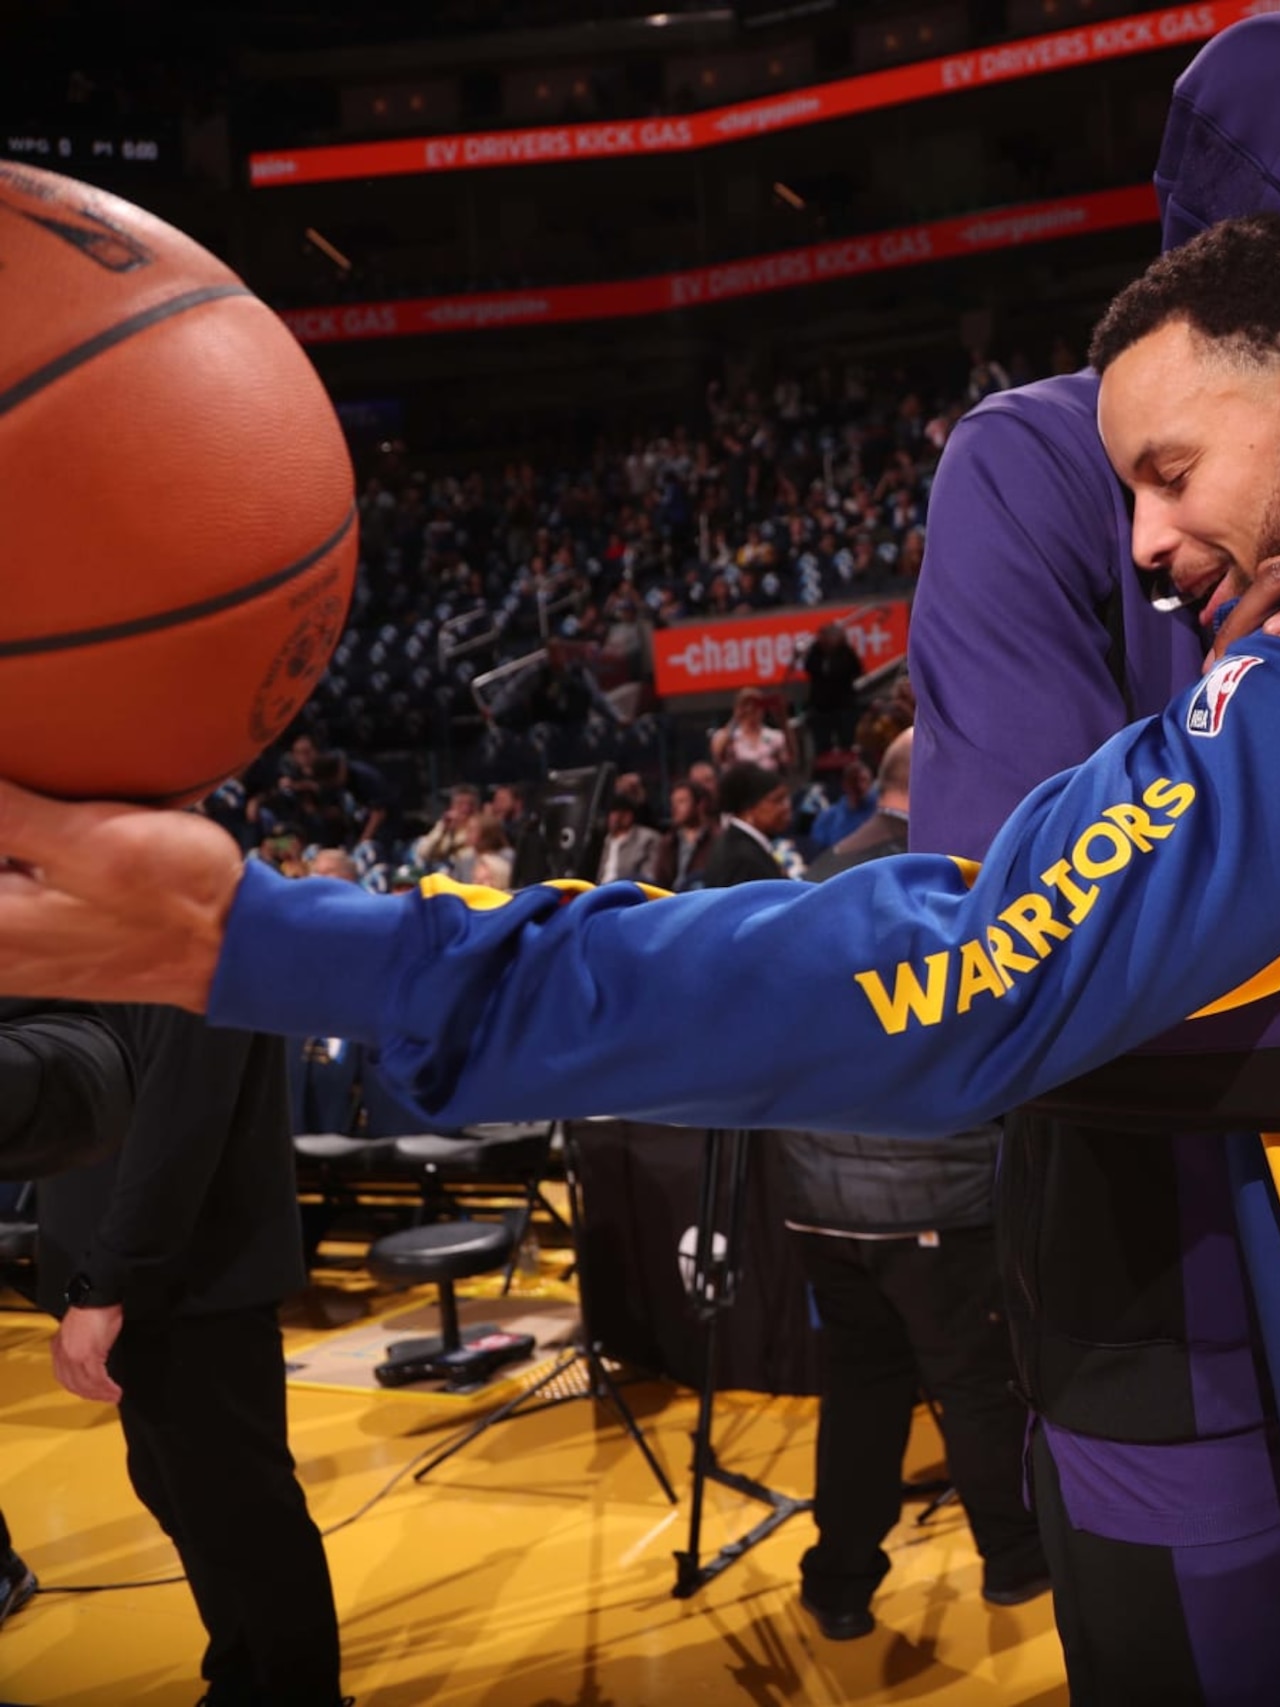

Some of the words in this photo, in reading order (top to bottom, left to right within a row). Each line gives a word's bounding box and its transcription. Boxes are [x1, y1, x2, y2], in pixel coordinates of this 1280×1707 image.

[942, 59, 973, 88] EV
[980, 33, 1088, 80] DRIVERS
[1093, 20, 1153, 54] KICK
[1159, 8, 1216, 43] GAS
[425, 140, 457, 167] EV
[463, 131, 570, 163] DRIVERS
[575, 126, 634, 153] KICK
[640, 120, 692, 149] GAS
[671, 276, 701, 304] EV
[708, 253, 811, 296] DRIVERS
[815, 242, 873, 273] KICK
[879, 230, 933, 262] GAS
[341, 305, 398, 335] GAS
[1190, 709, 1209, 729] NBA
[854, 777, 1196, 1035] WARRIORS
